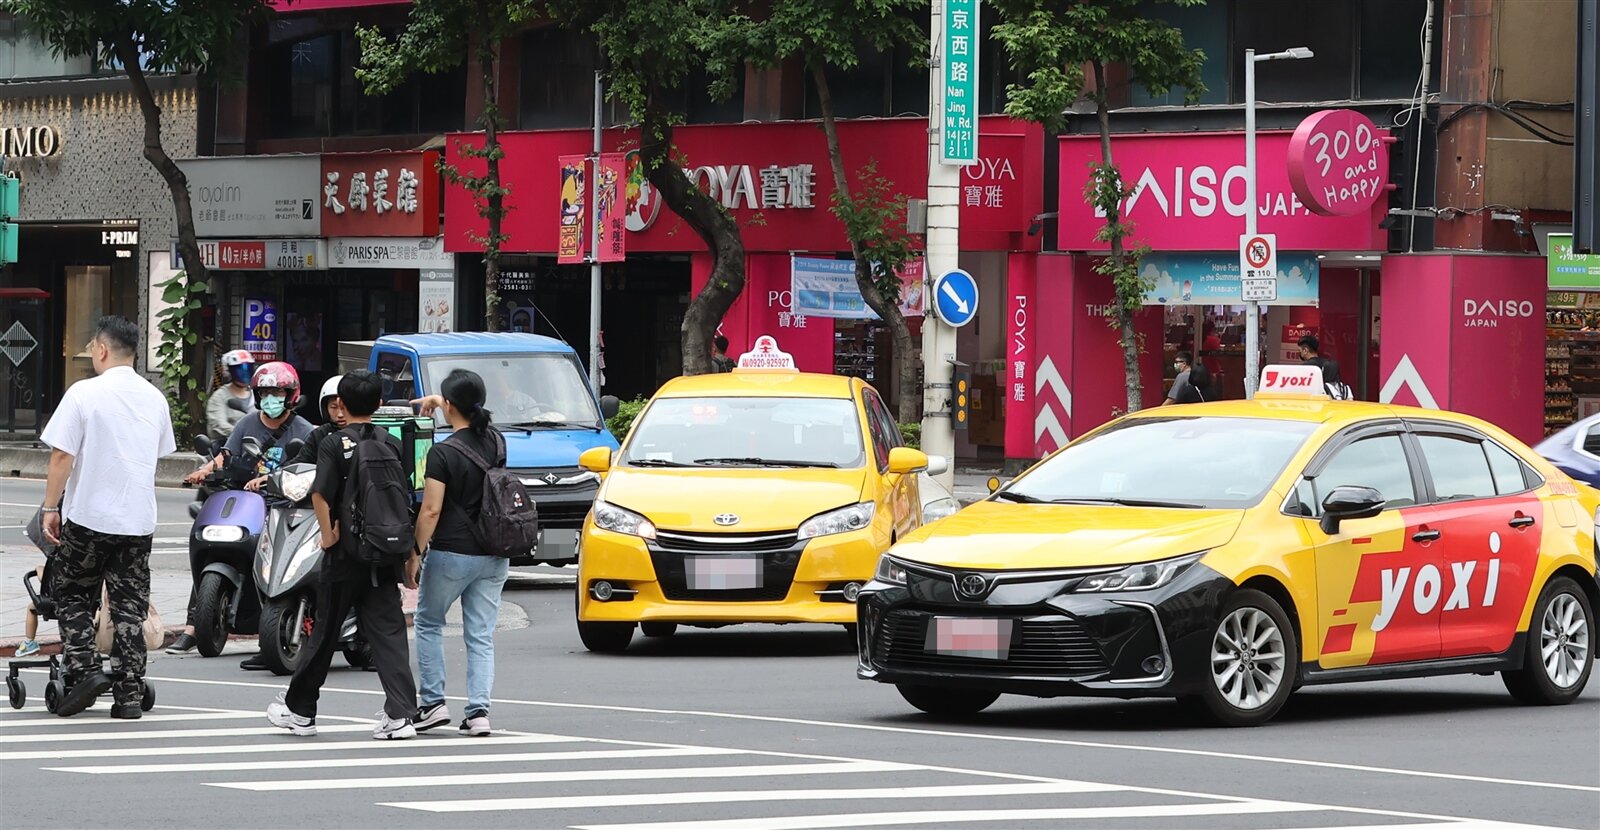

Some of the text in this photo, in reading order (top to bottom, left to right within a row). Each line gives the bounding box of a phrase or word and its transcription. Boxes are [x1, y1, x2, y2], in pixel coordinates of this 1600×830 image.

[948, 86, 964, 97] Nan
[947, 102, 966, 116] Jing
[947, 117, 972, 128] W. Rd.
[961, 158, 1015, 180] OYA
[1344, 150, 1377, 179] and
[682, 164, 758, 209] OYA
[760, 164, 816, 209] 寶雅
[1324, 176, 1380, 207] Happy
[964, 185, 1003, 208] 寶雅
[1259, 192, 1310, 216] JAP
[348, 246, 389, 259] PARIS SPA
[1212, 263, 1227, 272] Have
[768, 291, 795, 307] PO
[1464, 300, 1533, 317] DAISO
[245, 299, 263, 328] P
[252, 323, 271, 339] 40
[1464, 320, 1497, 328] JAPAN
[1013, 295, 1027, 401] POYA 寶雅
[1280, 372, 1314, 388] yoxi
[1370, 531, 1501, 632] yoxi
